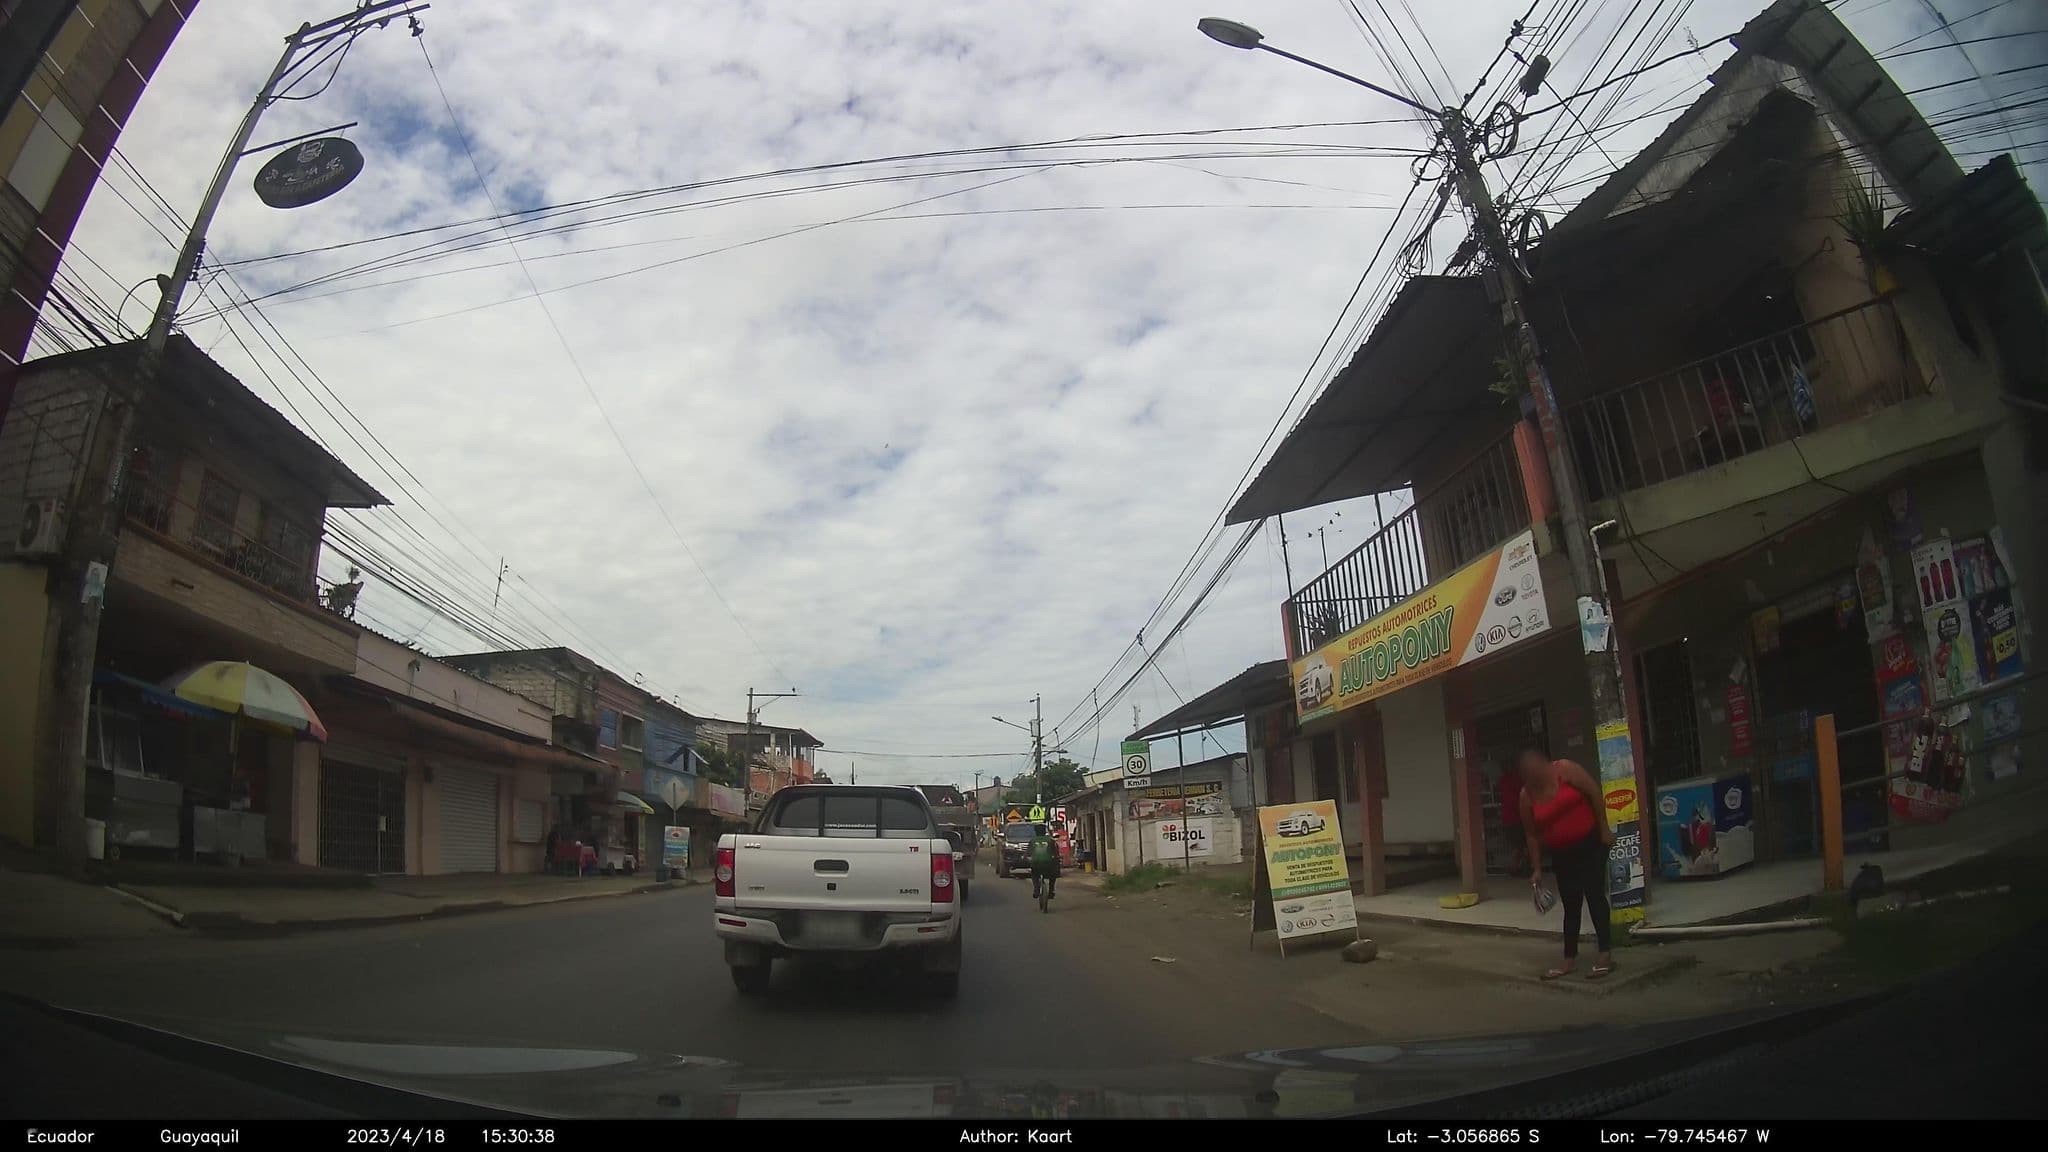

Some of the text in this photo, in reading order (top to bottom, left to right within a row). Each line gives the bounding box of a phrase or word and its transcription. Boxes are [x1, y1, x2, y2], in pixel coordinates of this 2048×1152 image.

[1348, 595, 1437, 651] REPUESTOS AUTOMOTRICES
[1489, 629, 1503, 642] KIA
[1339, 605, 1454, 697] AUTOPONY
[1130, 760, 1142, 770] 30
[1127, 779, 1148, 787] Km/h
[1169, 830, 1205, 842] BIZOL
[1609, 846, 1640, 861] GOLD
[1300, 919, 1314, 928] KIA
